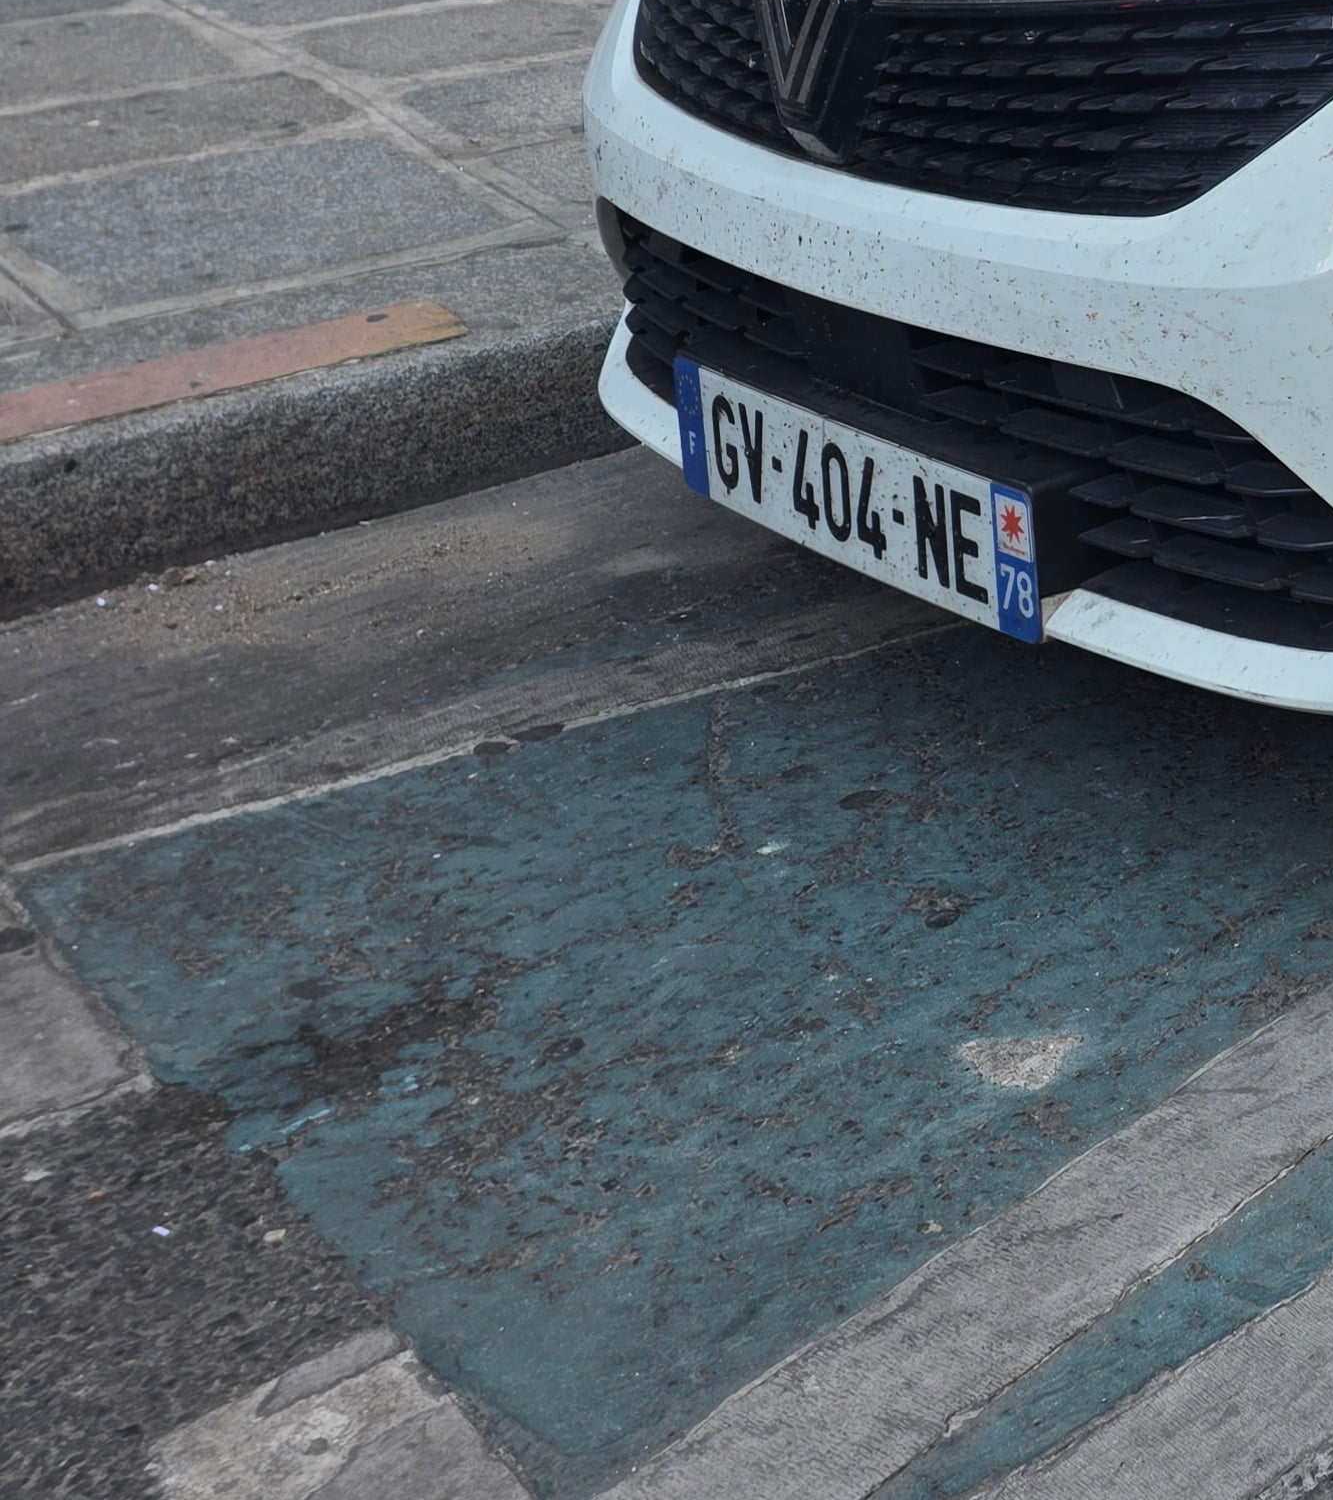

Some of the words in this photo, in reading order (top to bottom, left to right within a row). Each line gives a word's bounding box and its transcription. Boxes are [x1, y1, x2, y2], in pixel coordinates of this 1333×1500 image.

[688, 430, 697, 456] F
[711, 394, 989, 605] GV-404-NE
[1000, 563, 1034, 618] 78
